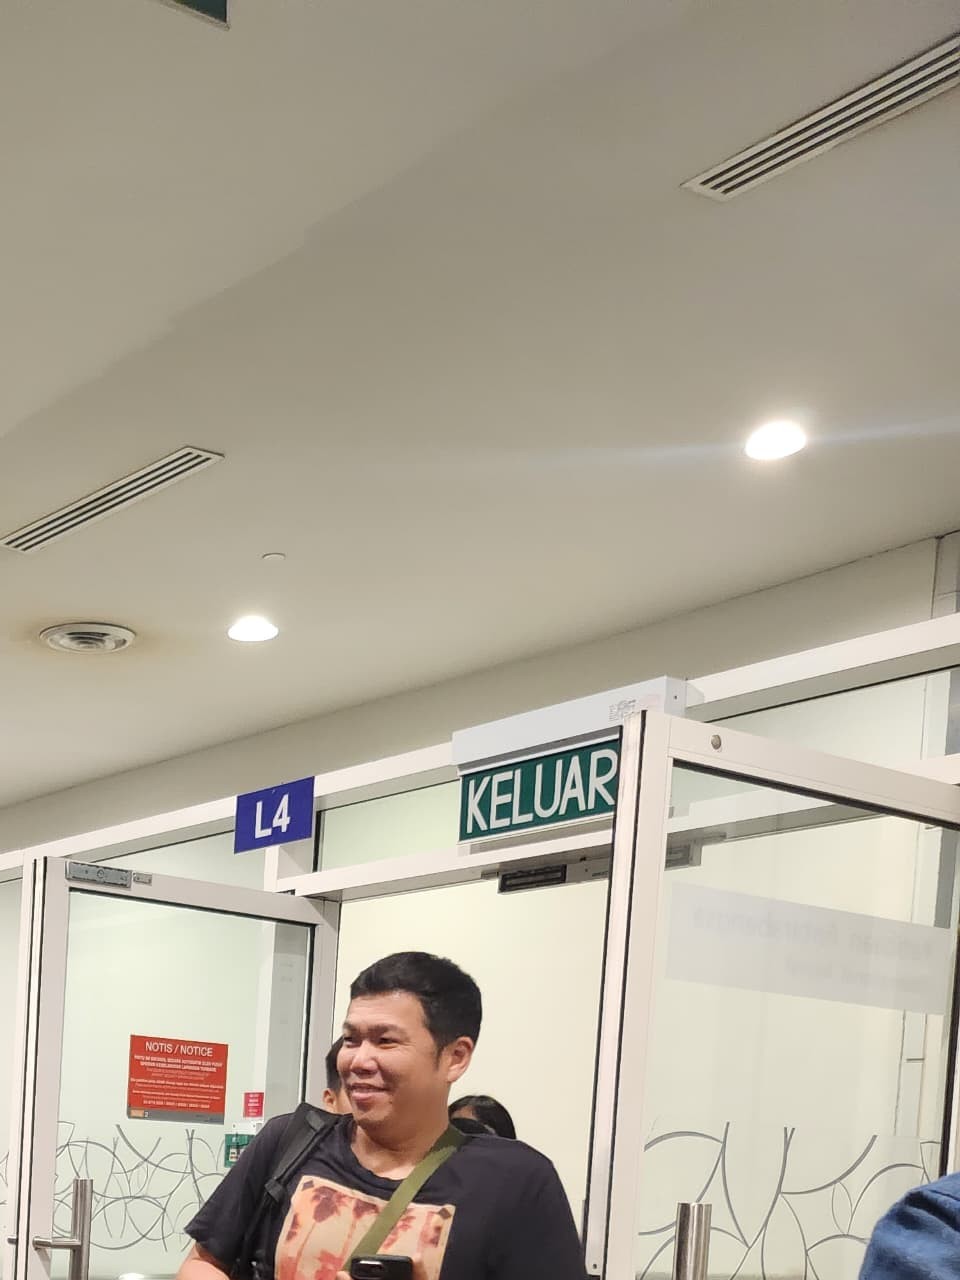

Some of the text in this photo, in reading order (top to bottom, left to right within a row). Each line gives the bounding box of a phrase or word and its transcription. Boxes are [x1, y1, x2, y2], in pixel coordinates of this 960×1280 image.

[466, 749, 618, 833] KELUAR
[255, 792, 291, 839] L4
[145, 1041, 173, 1054] NOTIS
[180, 1045, 213, 1057] NOTICE
